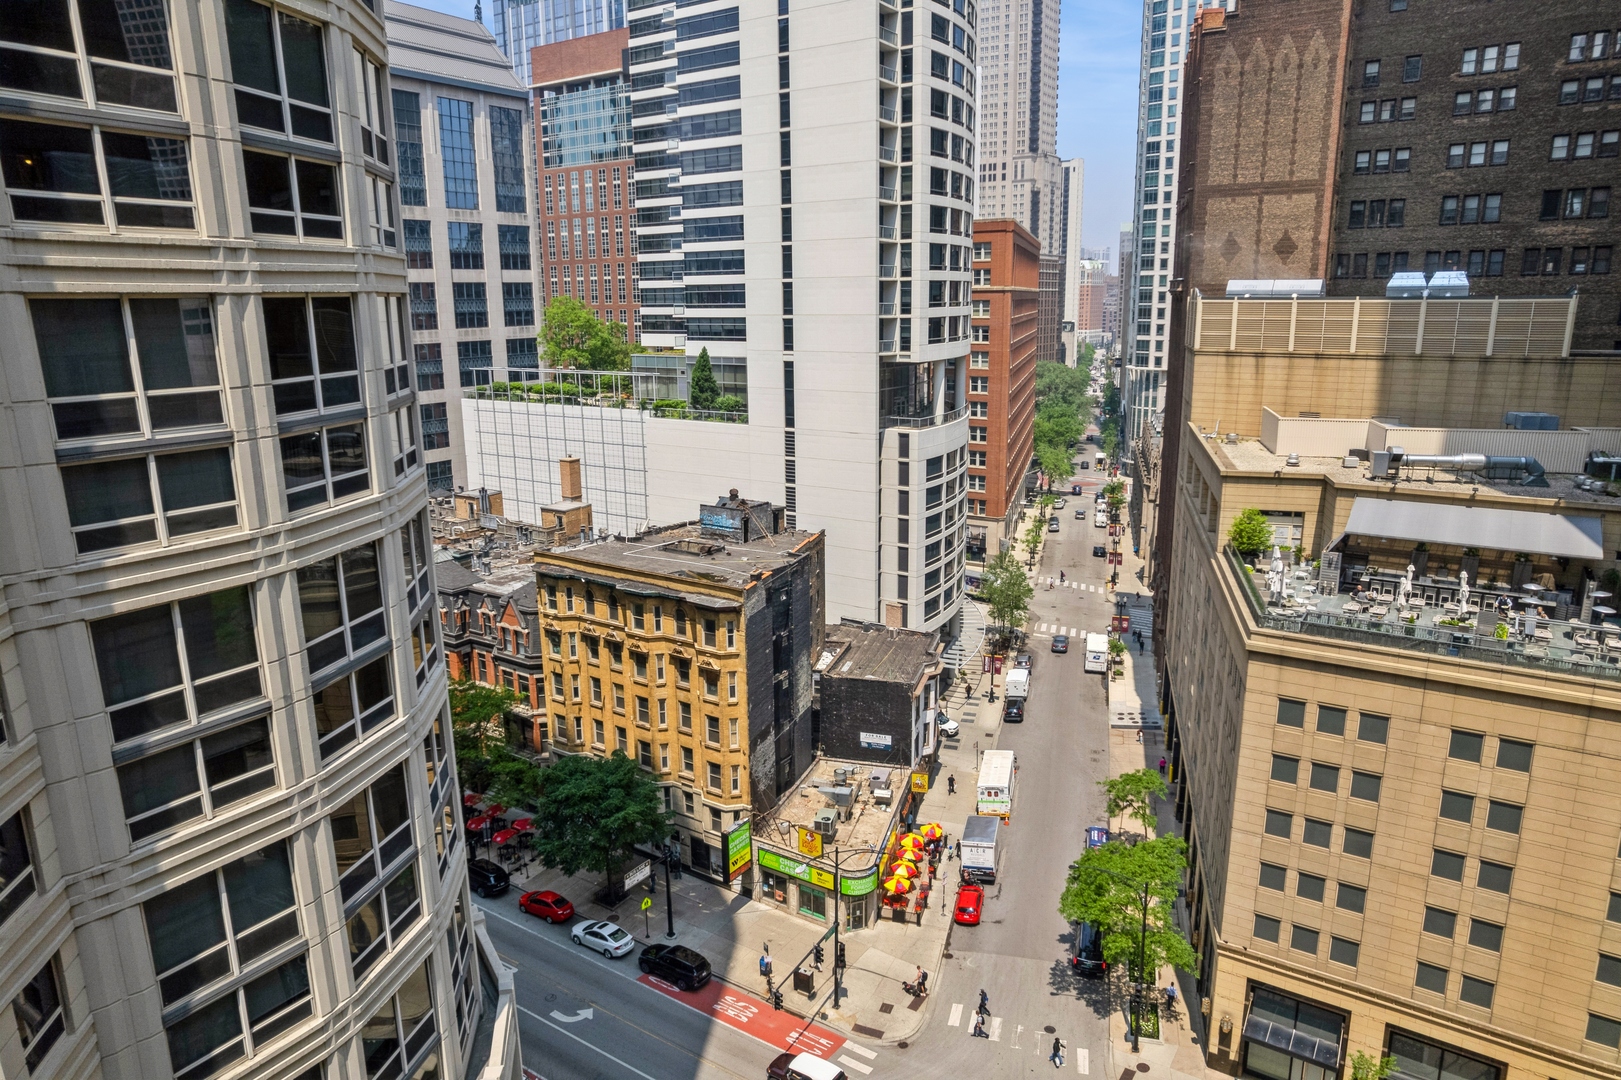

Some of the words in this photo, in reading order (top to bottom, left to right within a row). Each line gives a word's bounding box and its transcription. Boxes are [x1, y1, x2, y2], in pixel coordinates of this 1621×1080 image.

[730, 832, 749, 848] CHECKS
[780, 858, 809, 873] CHECS
[780, 865, 809, 879] CASED
